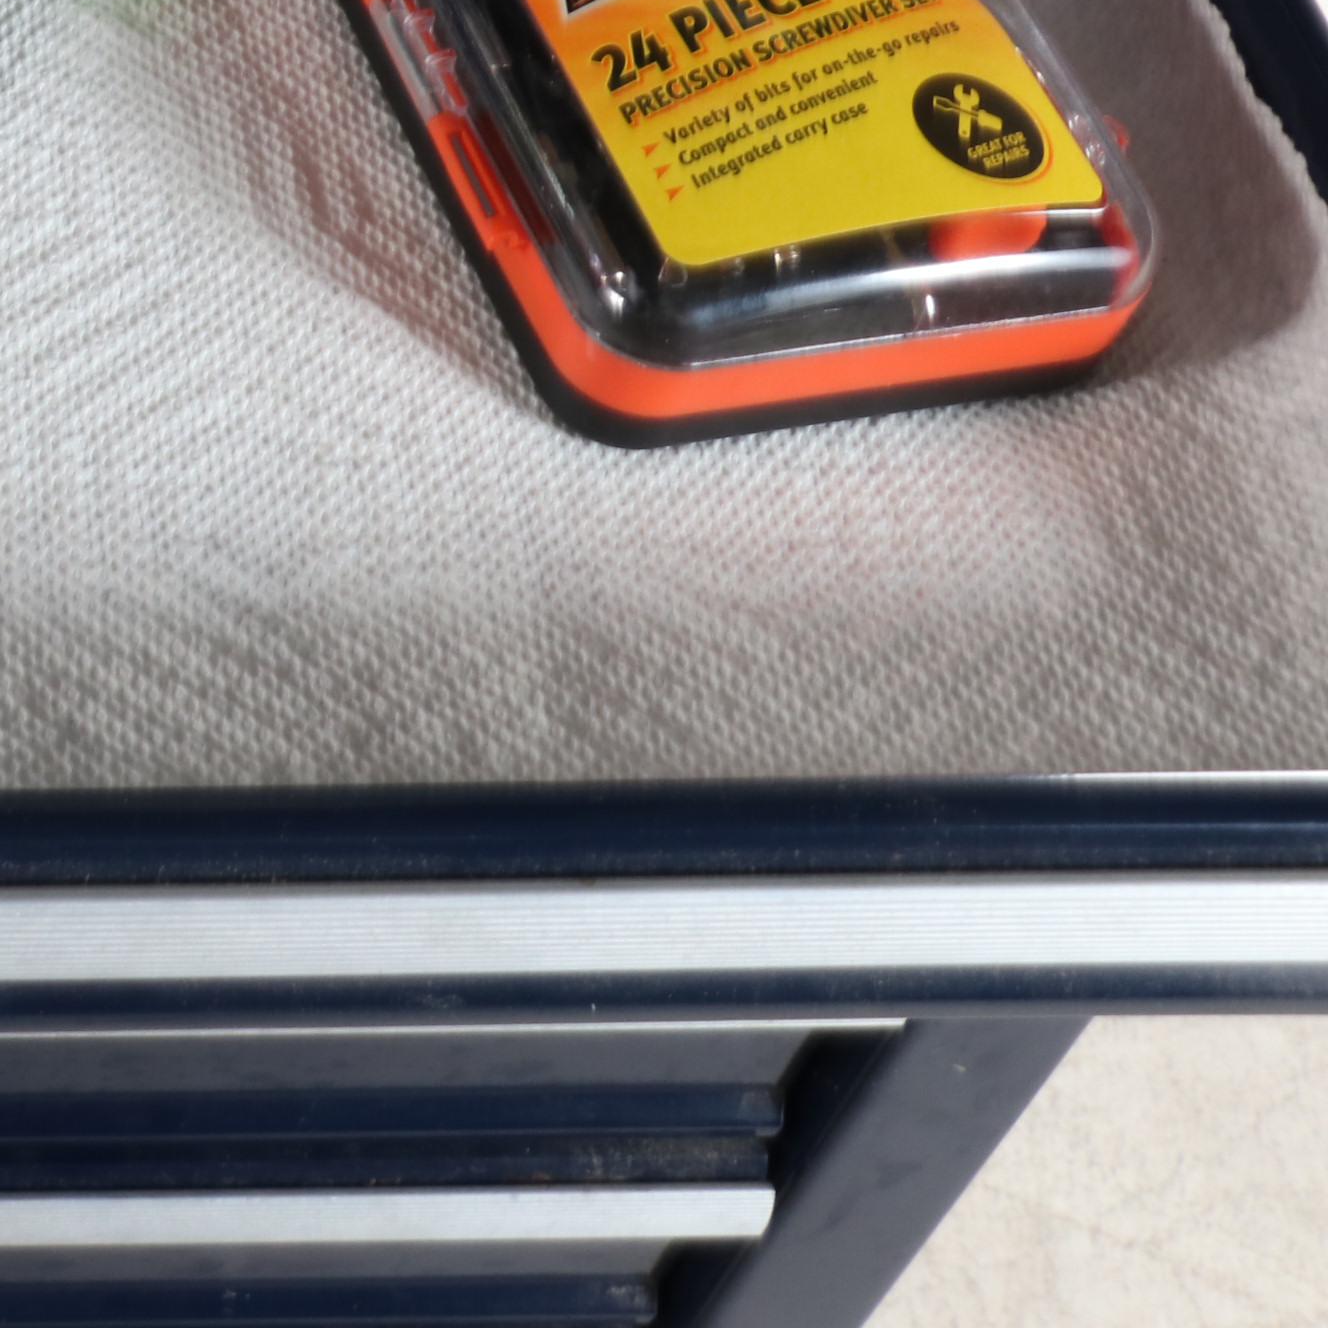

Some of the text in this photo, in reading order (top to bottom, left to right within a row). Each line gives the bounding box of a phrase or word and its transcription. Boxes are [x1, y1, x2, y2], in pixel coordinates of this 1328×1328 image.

[590, 28, 672, 93] 24
[618, 48, 753, 125] PRECISION
[663, 19, 961, 145] Variety of bits for on-the-go repairs
[678, 69, 879, 166] Compact and convenient
[690, 101, 870, 190] Integrated carry case
[967, 131, 1026, 159] GREAT FOR
[982, 143, 1031, 169] REPAIRS
